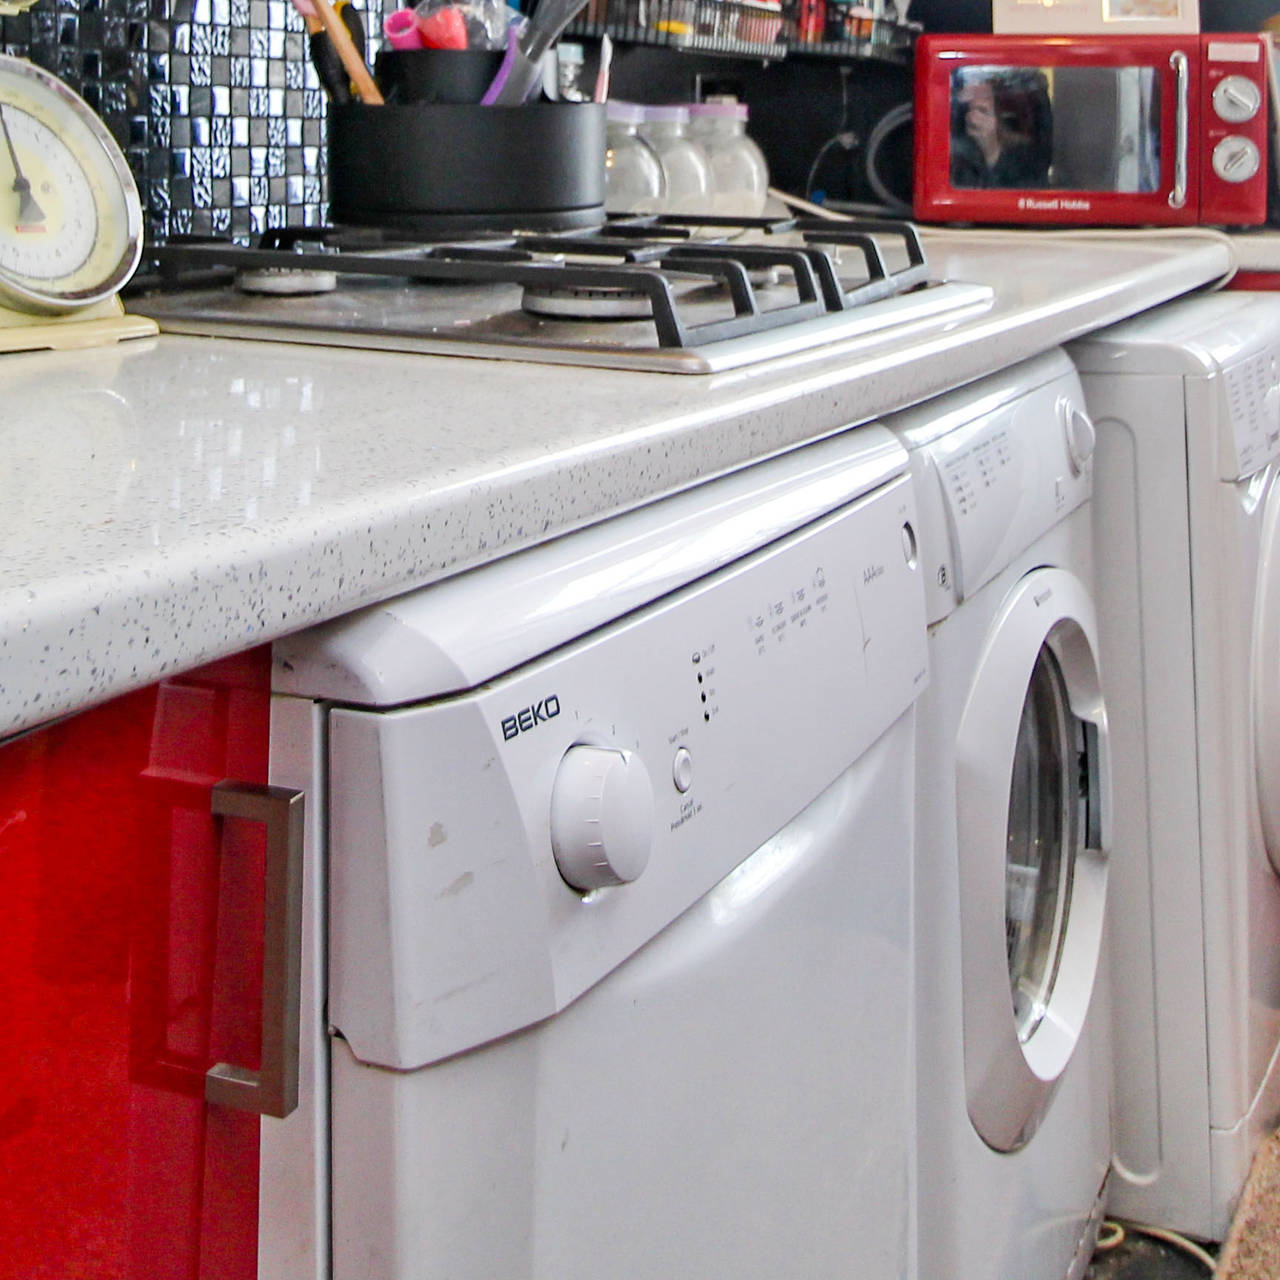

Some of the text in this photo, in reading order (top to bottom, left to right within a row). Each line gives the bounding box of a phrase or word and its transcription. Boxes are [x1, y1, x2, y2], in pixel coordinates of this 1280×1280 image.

[1026, 198, 1090, 211] Russell Hobbs
[501, 694, 561, 741] BEKO
